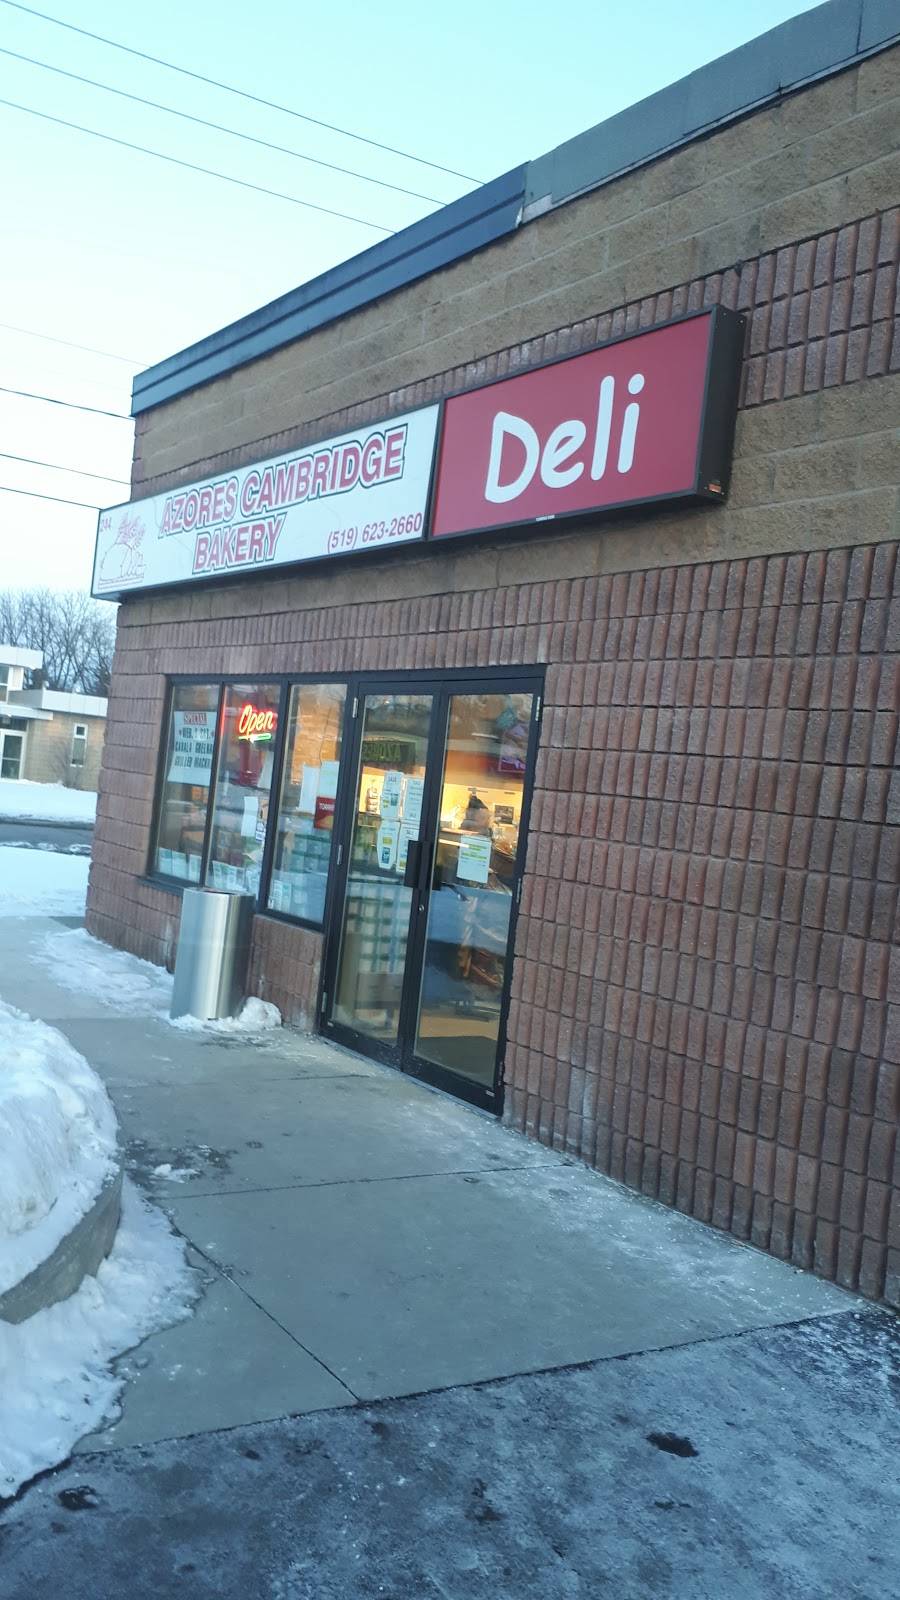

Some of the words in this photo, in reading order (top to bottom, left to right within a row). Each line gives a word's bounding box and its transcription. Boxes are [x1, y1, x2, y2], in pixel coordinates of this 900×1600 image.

[484, 373, 645, 504] Deli
[158, 476, 240, 538] AZORES
[240, 423, 408, 517] CAMBRIDGE
[192, 511, 287, 574] BAKERY
[327, 526, 358, 554] (519)
[362, 512, 423, 543] 623-2660
[239, 704, 275, 738] Open
